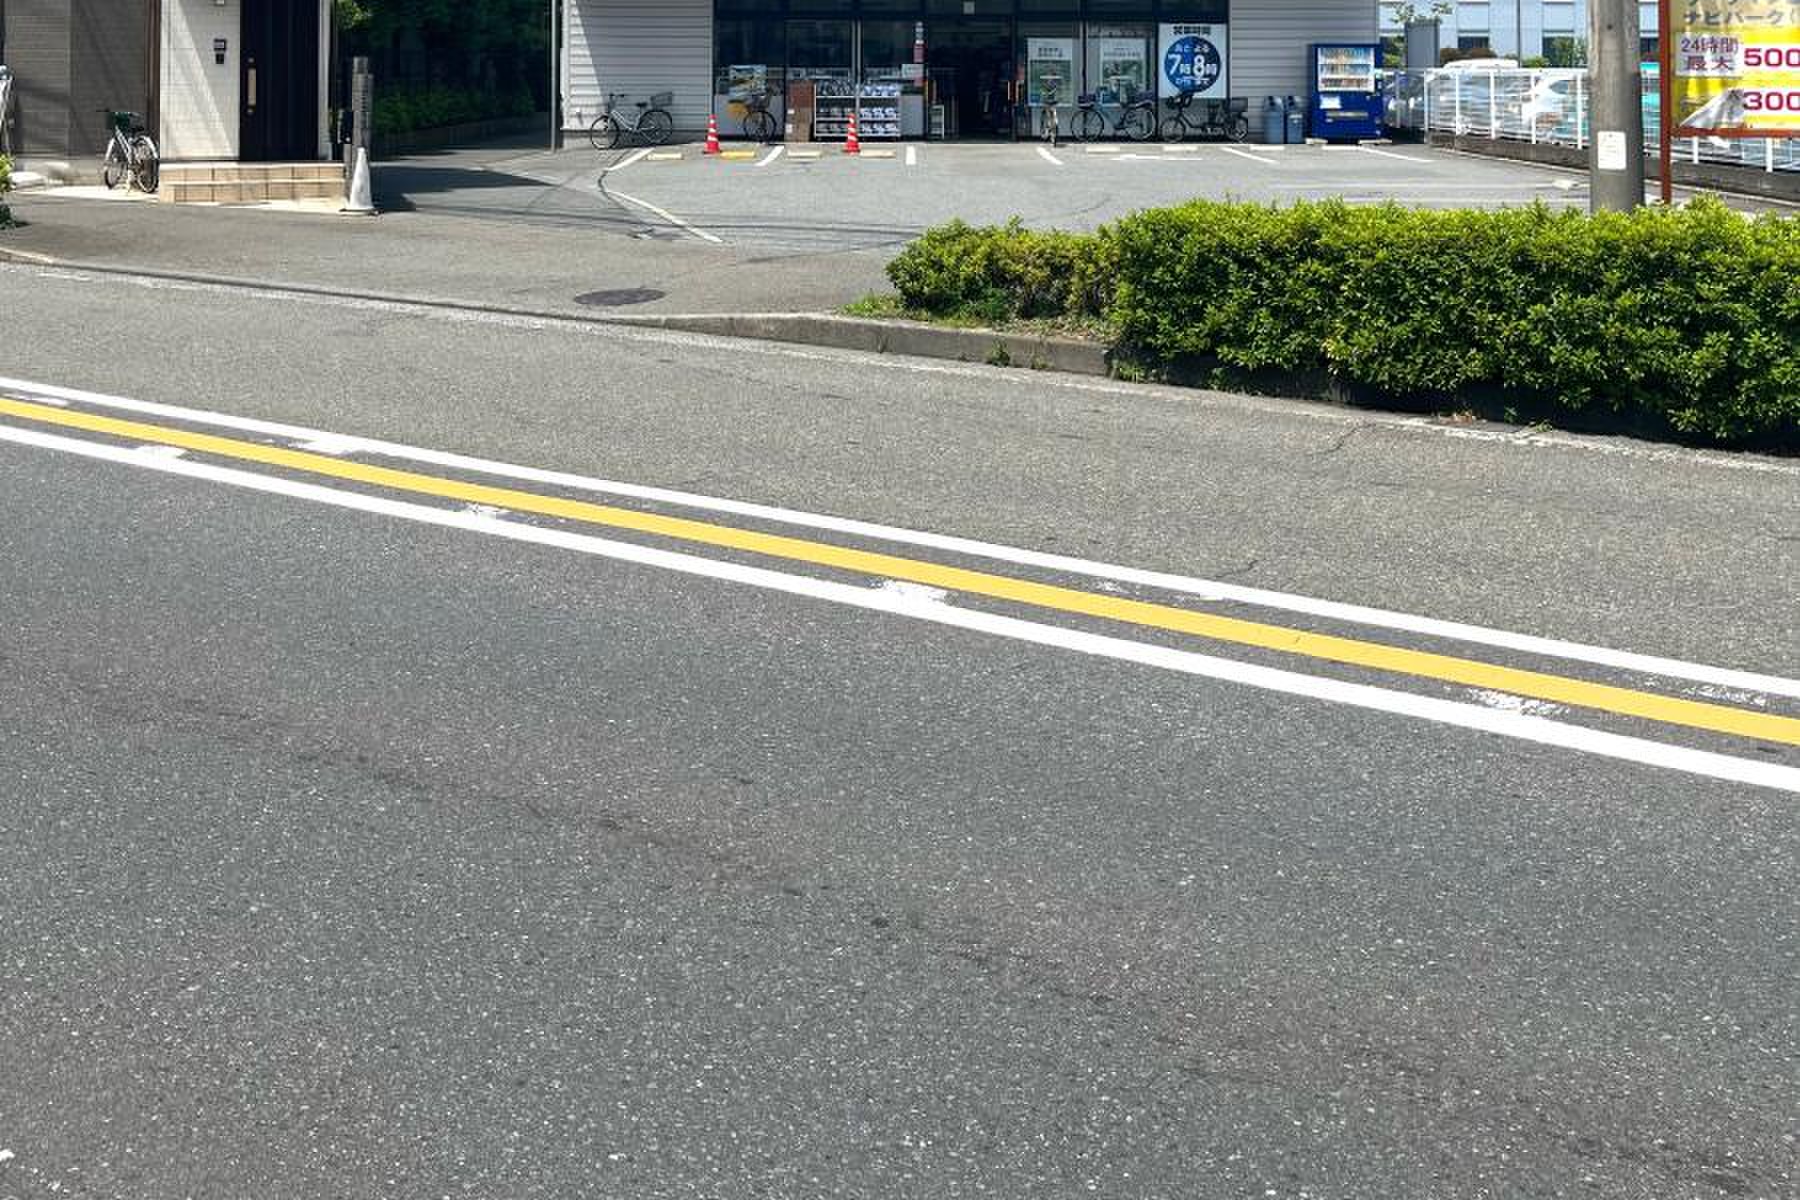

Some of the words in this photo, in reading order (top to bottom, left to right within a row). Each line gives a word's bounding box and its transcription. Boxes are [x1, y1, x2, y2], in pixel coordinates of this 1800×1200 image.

[1681, 36, 1739, 55] 24時間
[1687, 56, 1735, 71] 最大
[1744, 47, 1800, 68] 500
[1743, 91, 1800, 111] 300
